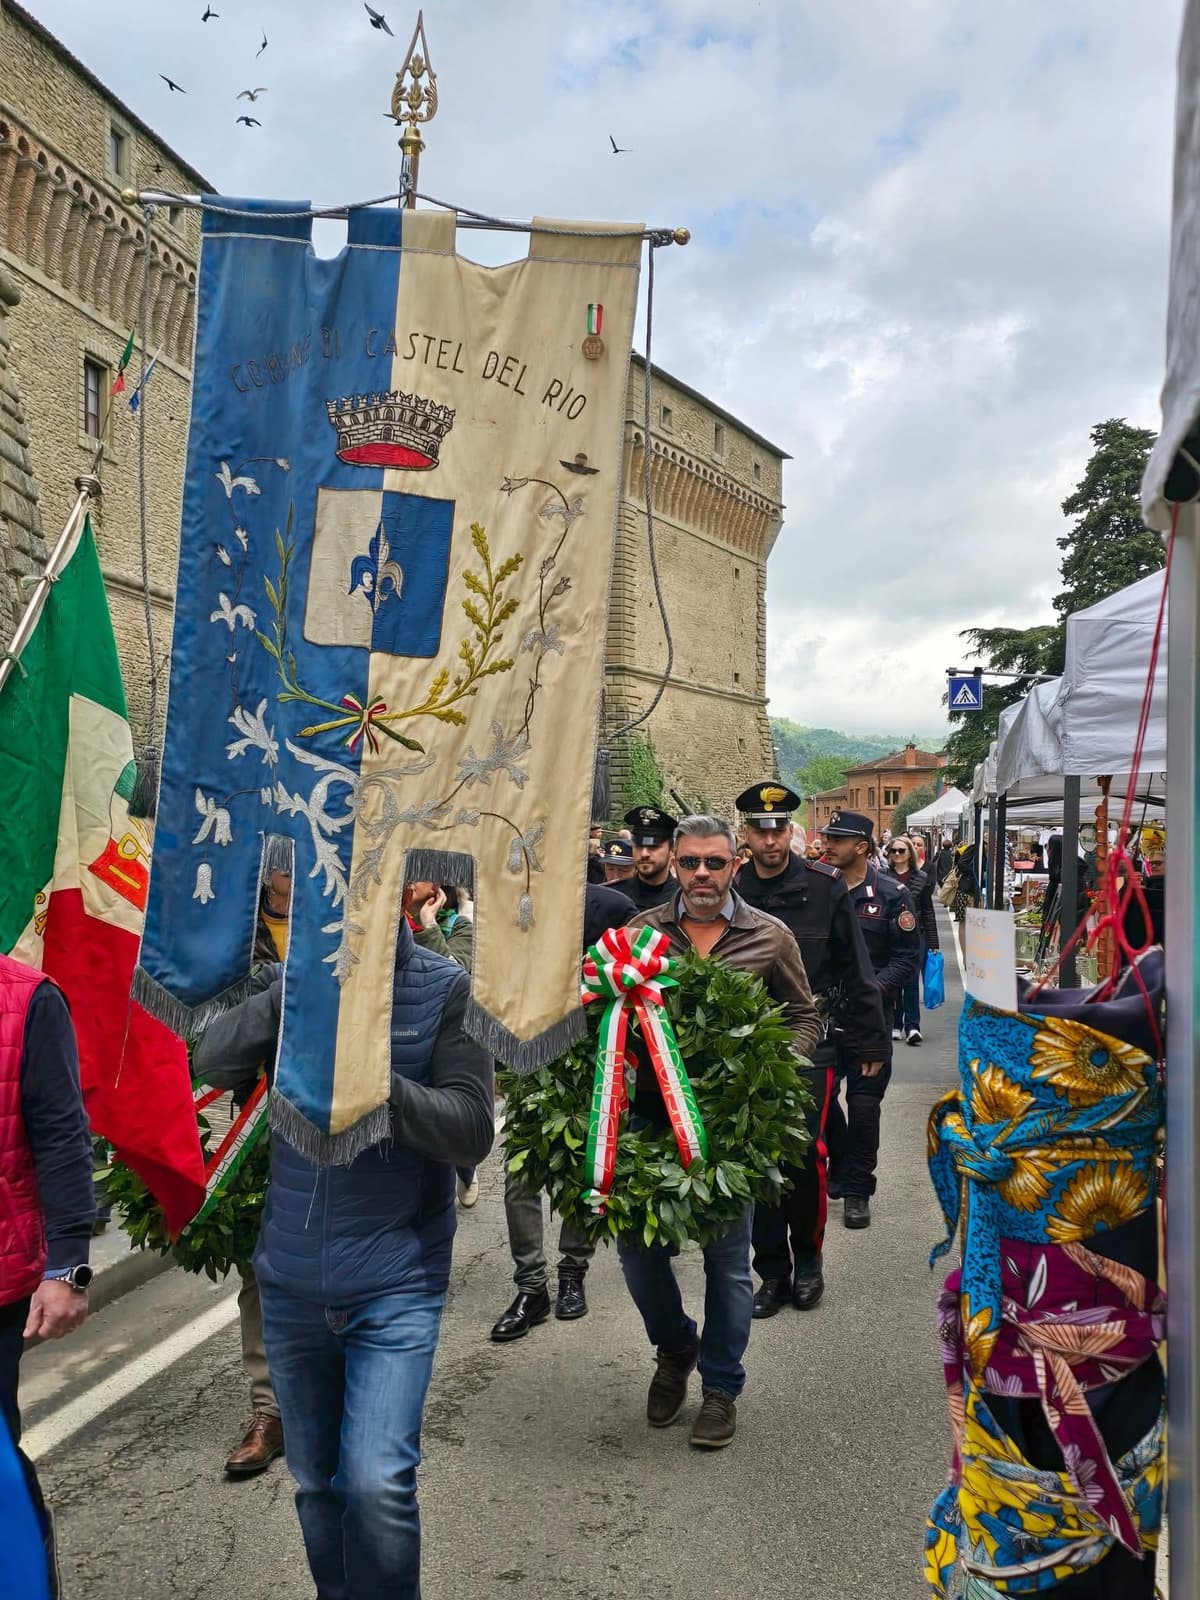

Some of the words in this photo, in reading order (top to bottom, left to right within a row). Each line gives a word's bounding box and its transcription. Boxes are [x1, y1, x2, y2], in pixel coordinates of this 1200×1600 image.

[320, 327, 341, 360] DI
[364, 327, 464, 374] CASTEL
[481, 350, 528, 396] DEL
[541, 378, 587, 420] RIO
[391, 1026, 418, 1036] olumbia
